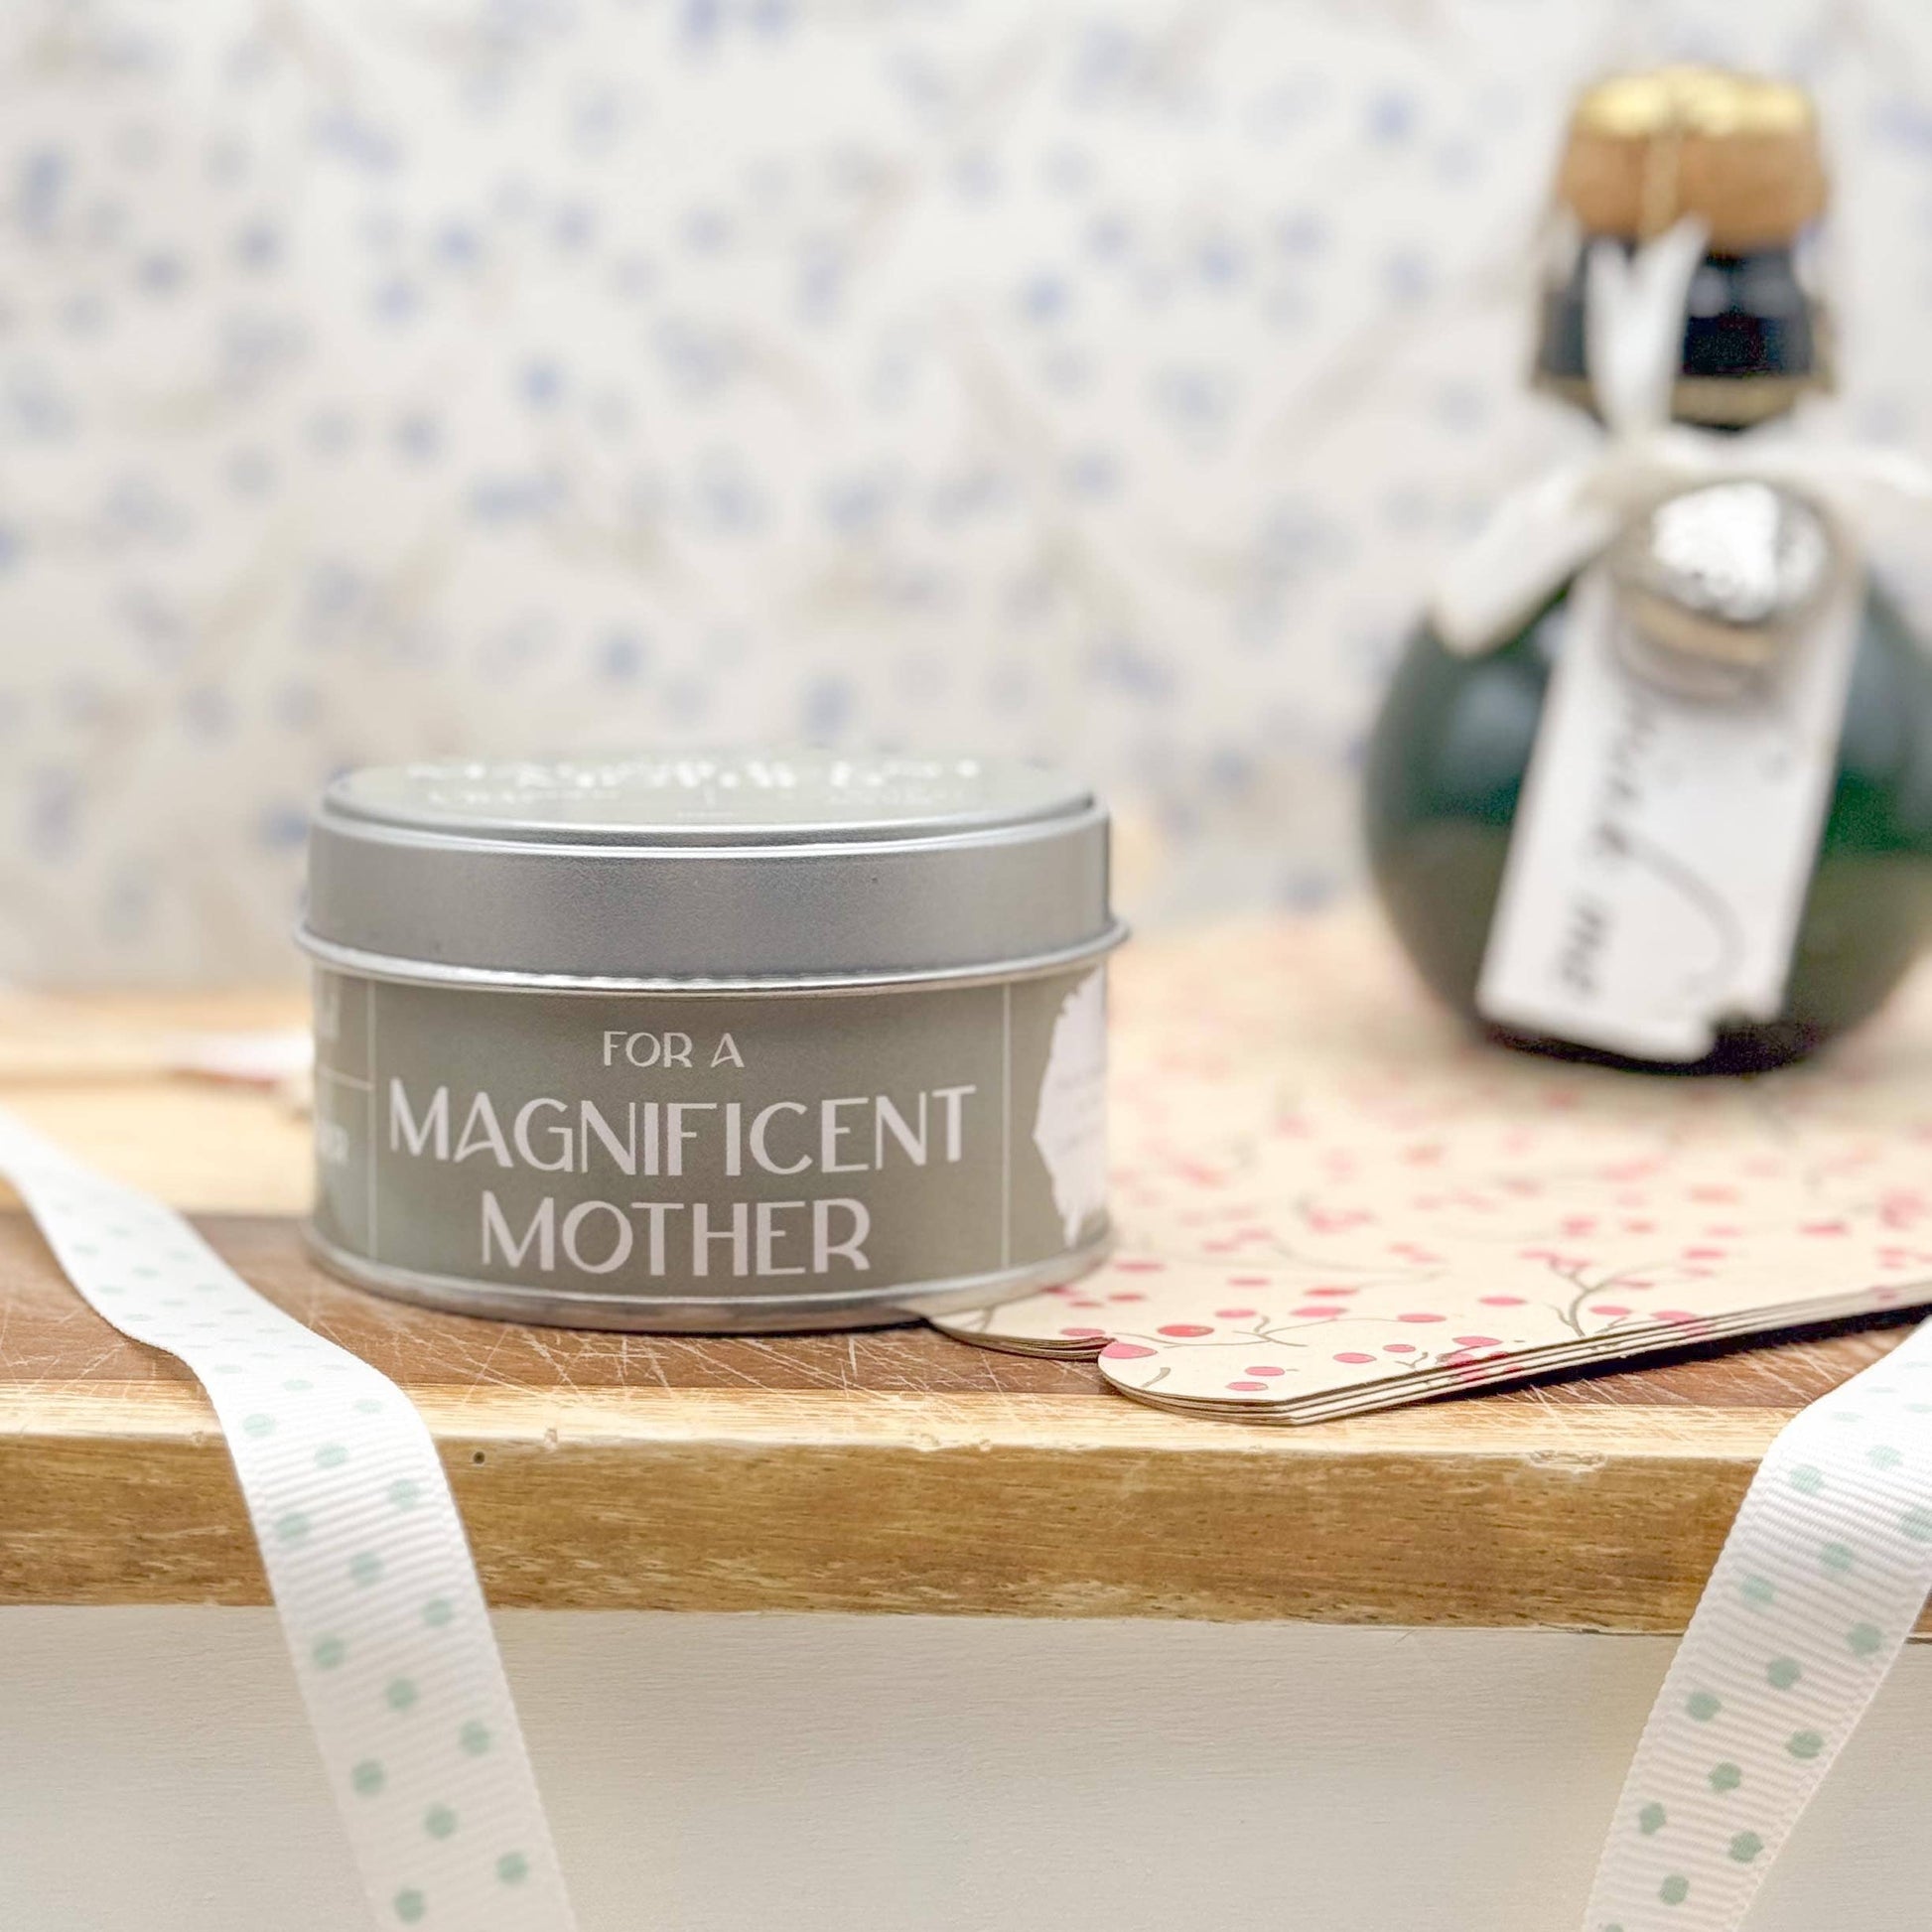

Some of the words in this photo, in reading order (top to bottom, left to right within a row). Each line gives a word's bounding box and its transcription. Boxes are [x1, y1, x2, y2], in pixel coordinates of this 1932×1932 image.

[602, 1030, 694, 1068] FOR
[710, 1032, 747, 1069] A
[389, 1077, 978, 1177] MAGNIFICENT
[481, 1190, 872, 1278] MOTHER
